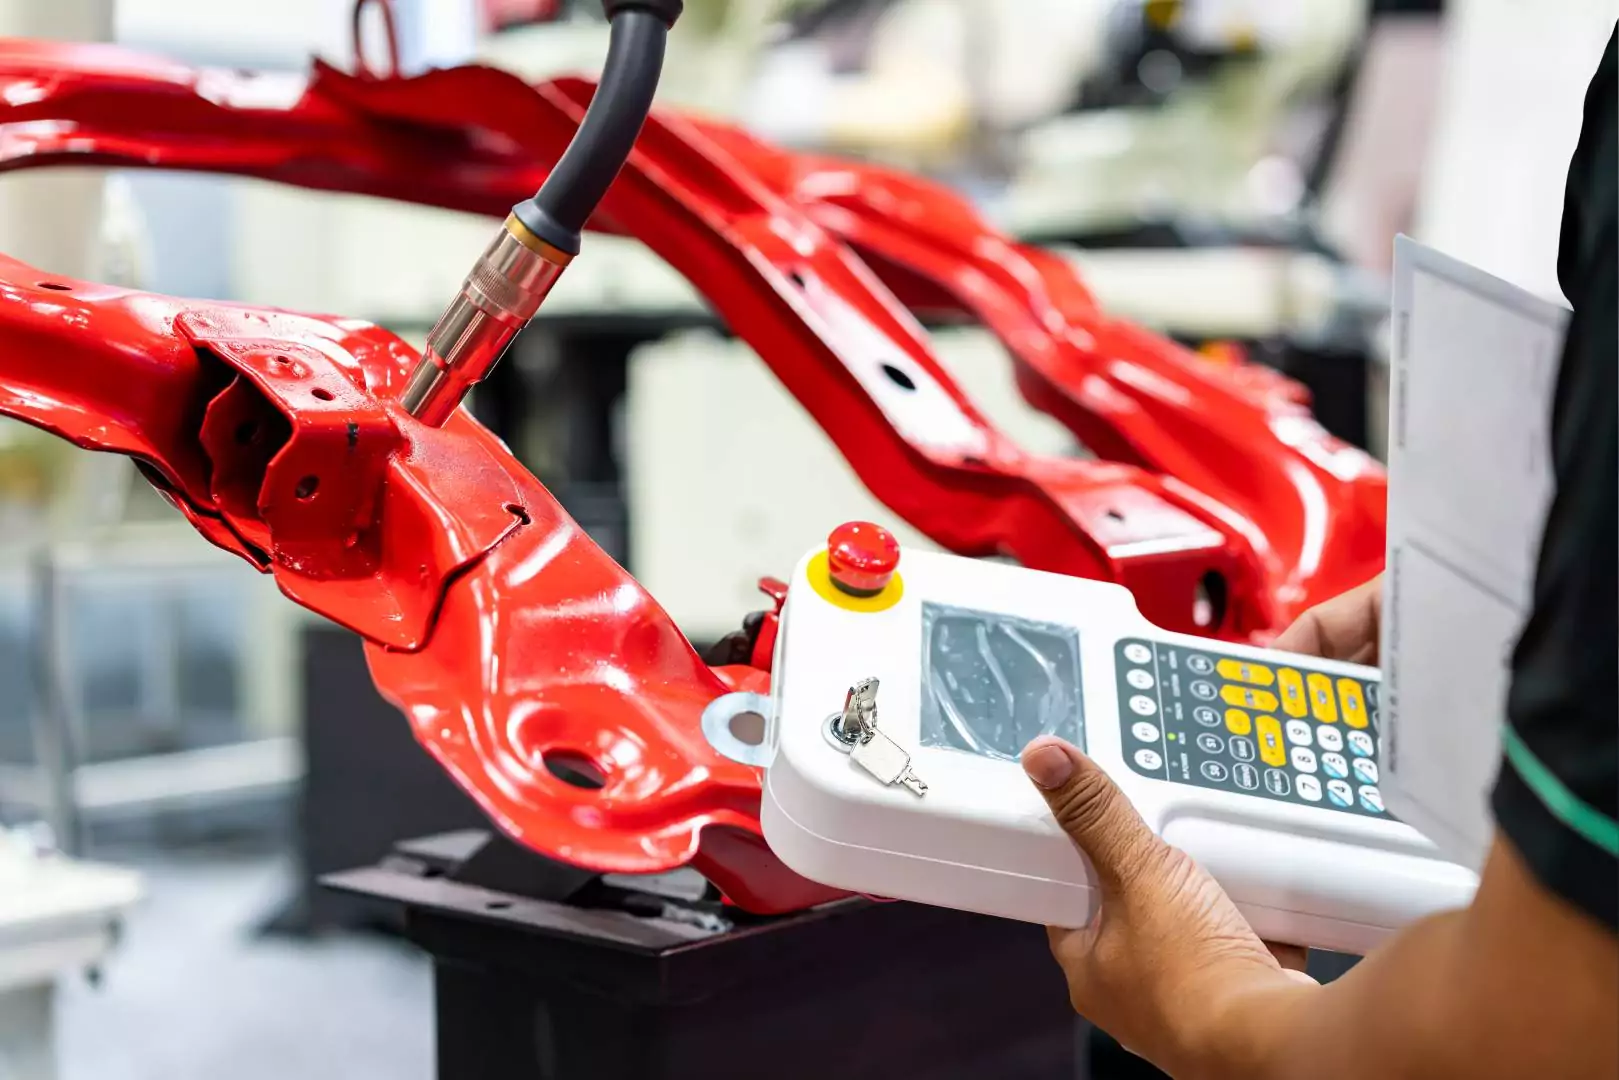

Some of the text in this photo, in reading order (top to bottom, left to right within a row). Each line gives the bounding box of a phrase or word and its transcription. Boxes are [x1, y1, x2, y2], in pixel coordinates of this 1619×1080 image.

[1293, 728, 1306, 736] 9
[1298, 755, 1311, 763] 8
[1302, 782, 1316, 791] 7
